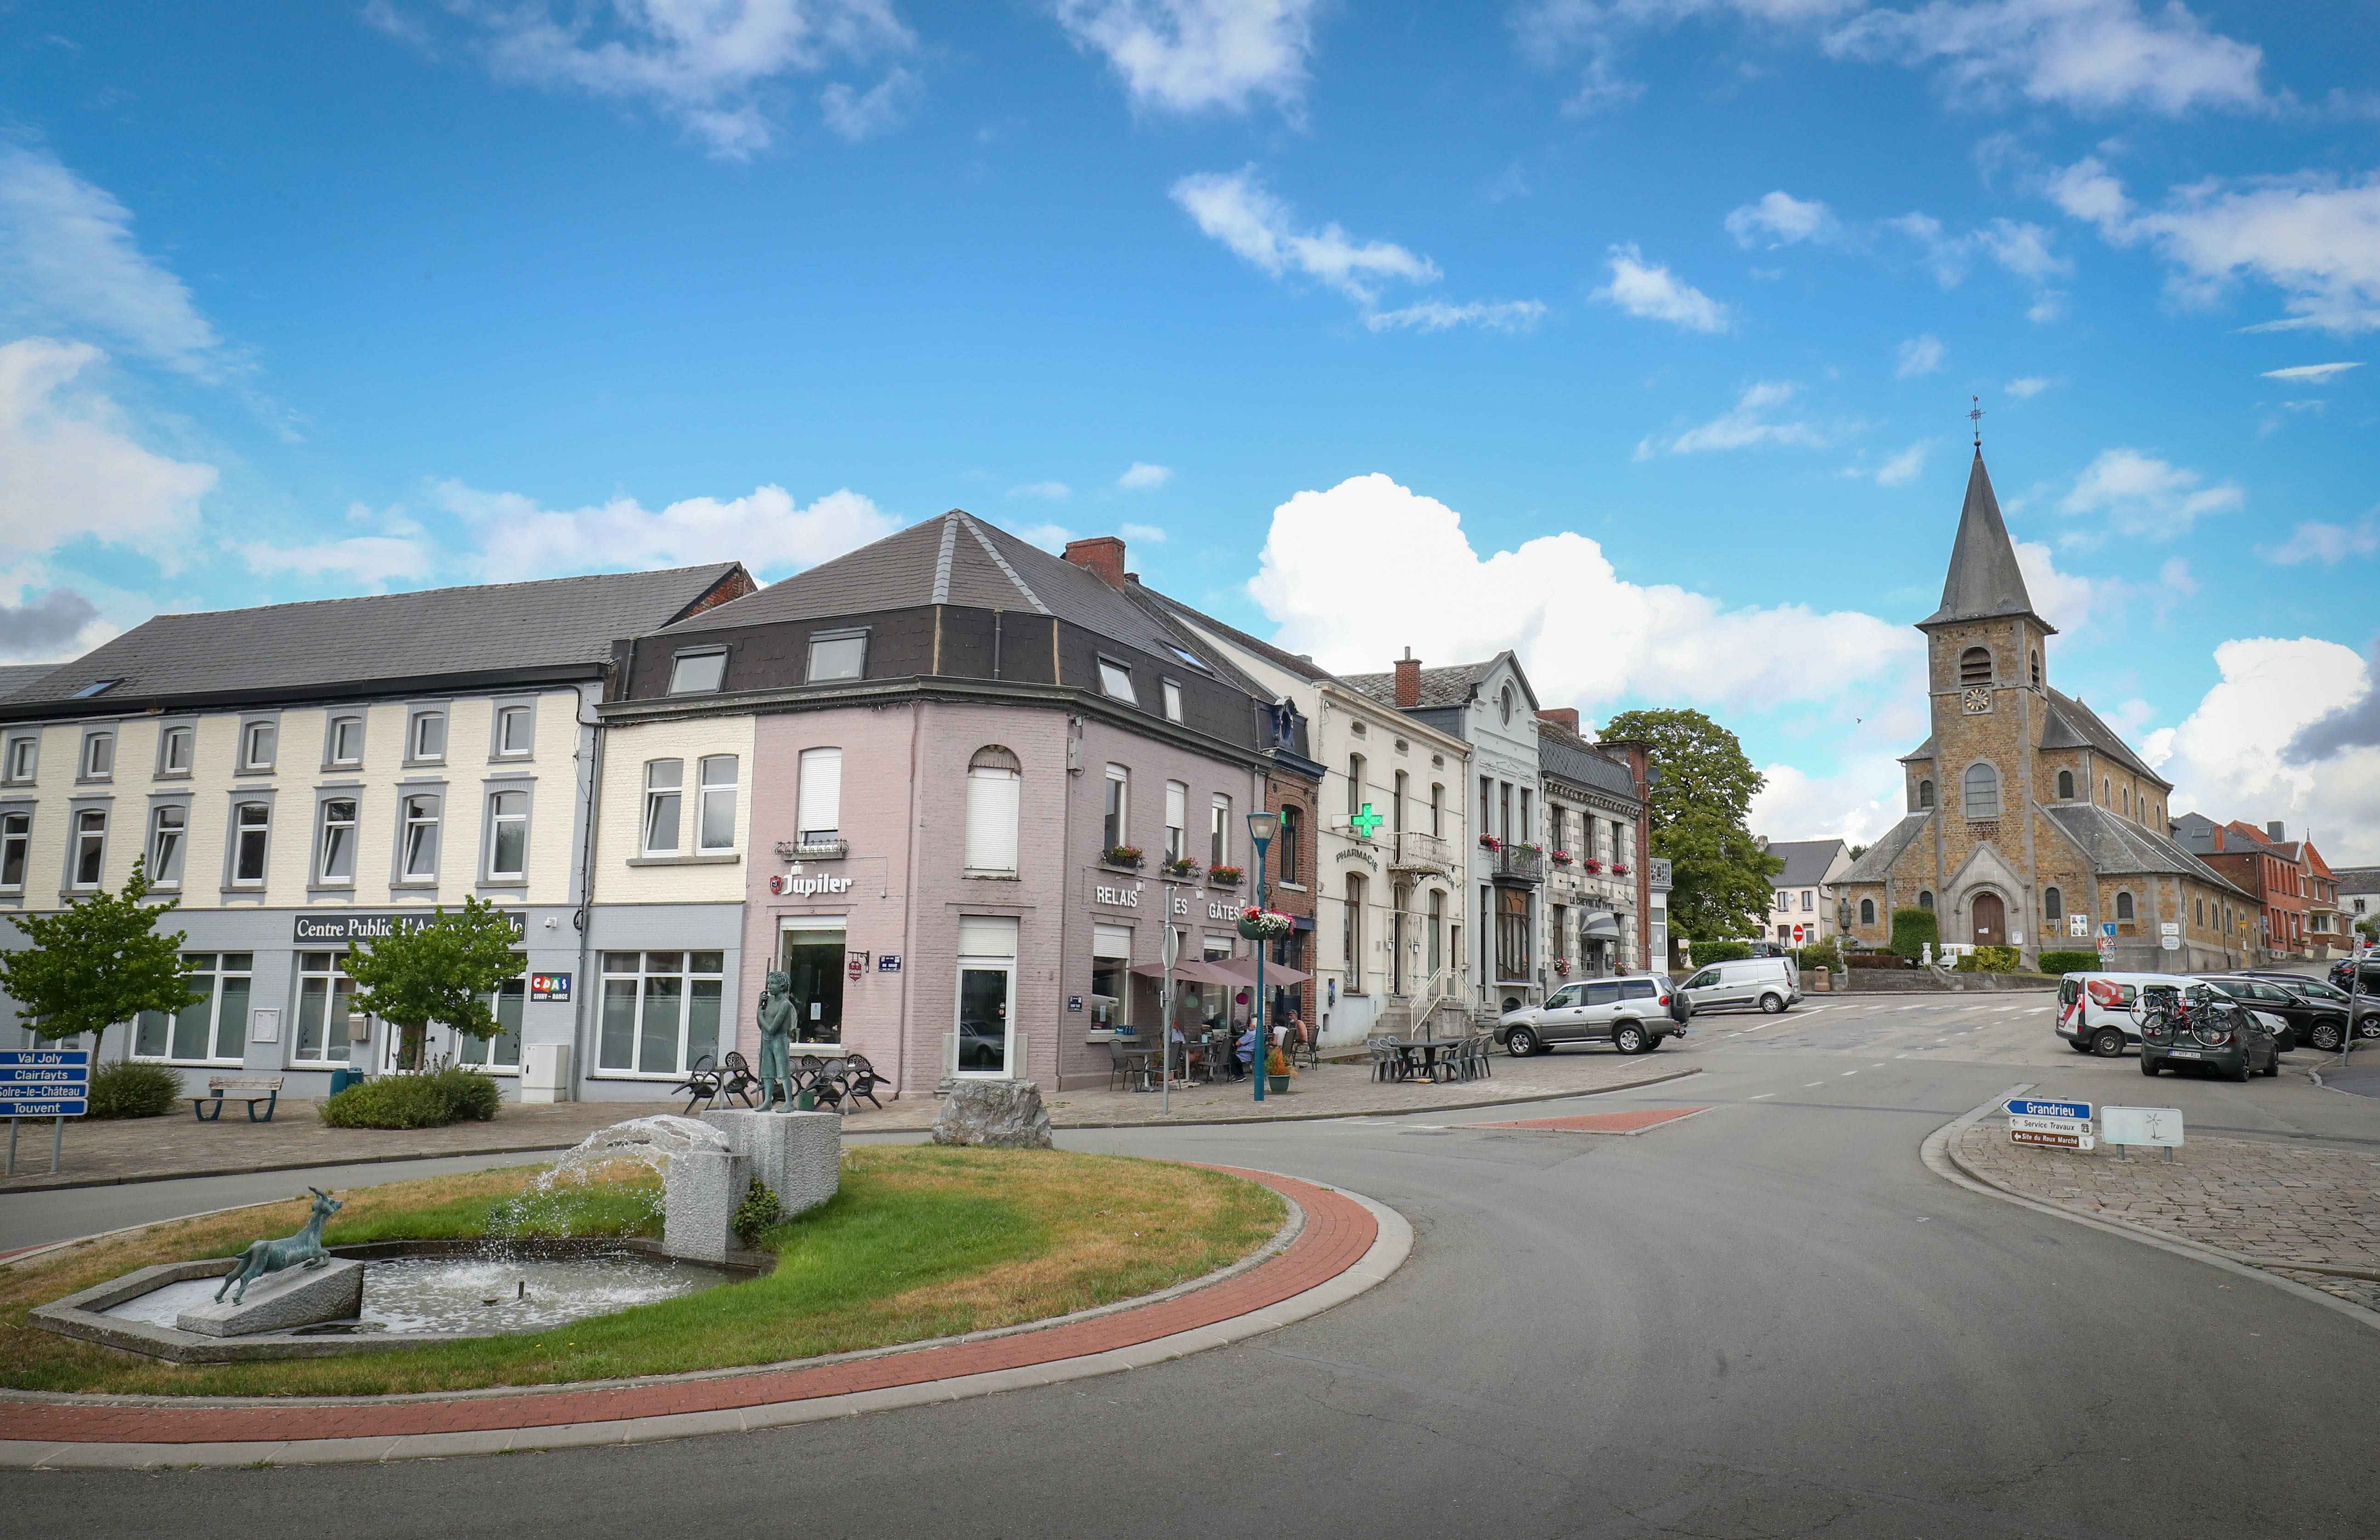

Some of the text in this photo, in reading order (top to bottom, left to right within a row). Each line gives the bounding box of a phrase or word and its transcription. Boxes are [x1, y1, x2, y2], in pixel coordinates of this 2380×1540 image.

[1336, 849, 1379, 872] PHARMACIE
[781, 873, 852, 898] Jupiler
[1096, 886, 1240, 921] RELAIS ES GÂTES
[297, 919, 344, 937] Centre
[347, 918, 393, 937] Public
[17, 1053, 62, 1064] Val Joly
[15, 1070, 68, 1081] Clairfayts
[0, 1086, 80, 1097] Solre-le-Château
[13, 1102, 61, 1113] Touvent
[2027, 1102, 2074, 1116] Grandrieu
[2024, 1120, 2075, 1131] Service Travaux
